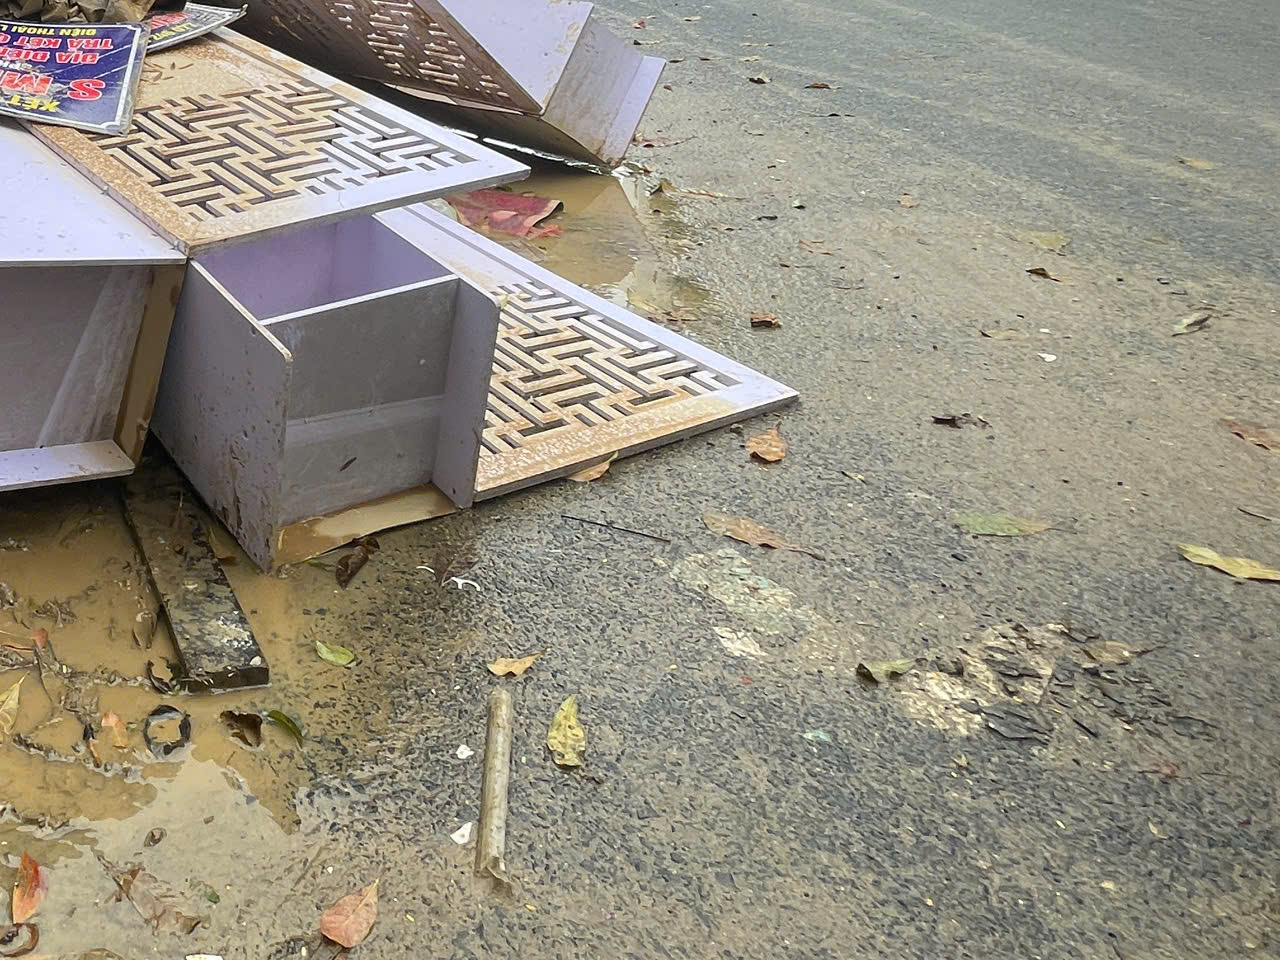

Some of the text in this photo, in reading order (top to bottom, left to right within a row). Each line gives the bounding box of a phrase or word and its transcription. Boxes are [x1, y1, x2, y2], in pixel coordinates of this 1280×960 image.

[14, 34, 62, 49] KẾT
[67, 38, 114, 52] TRẢ
[56, 49, 100, 64] ĐỊA
[67, 78, 106, 101] S
[7, 97, 61, 112] XÉT
